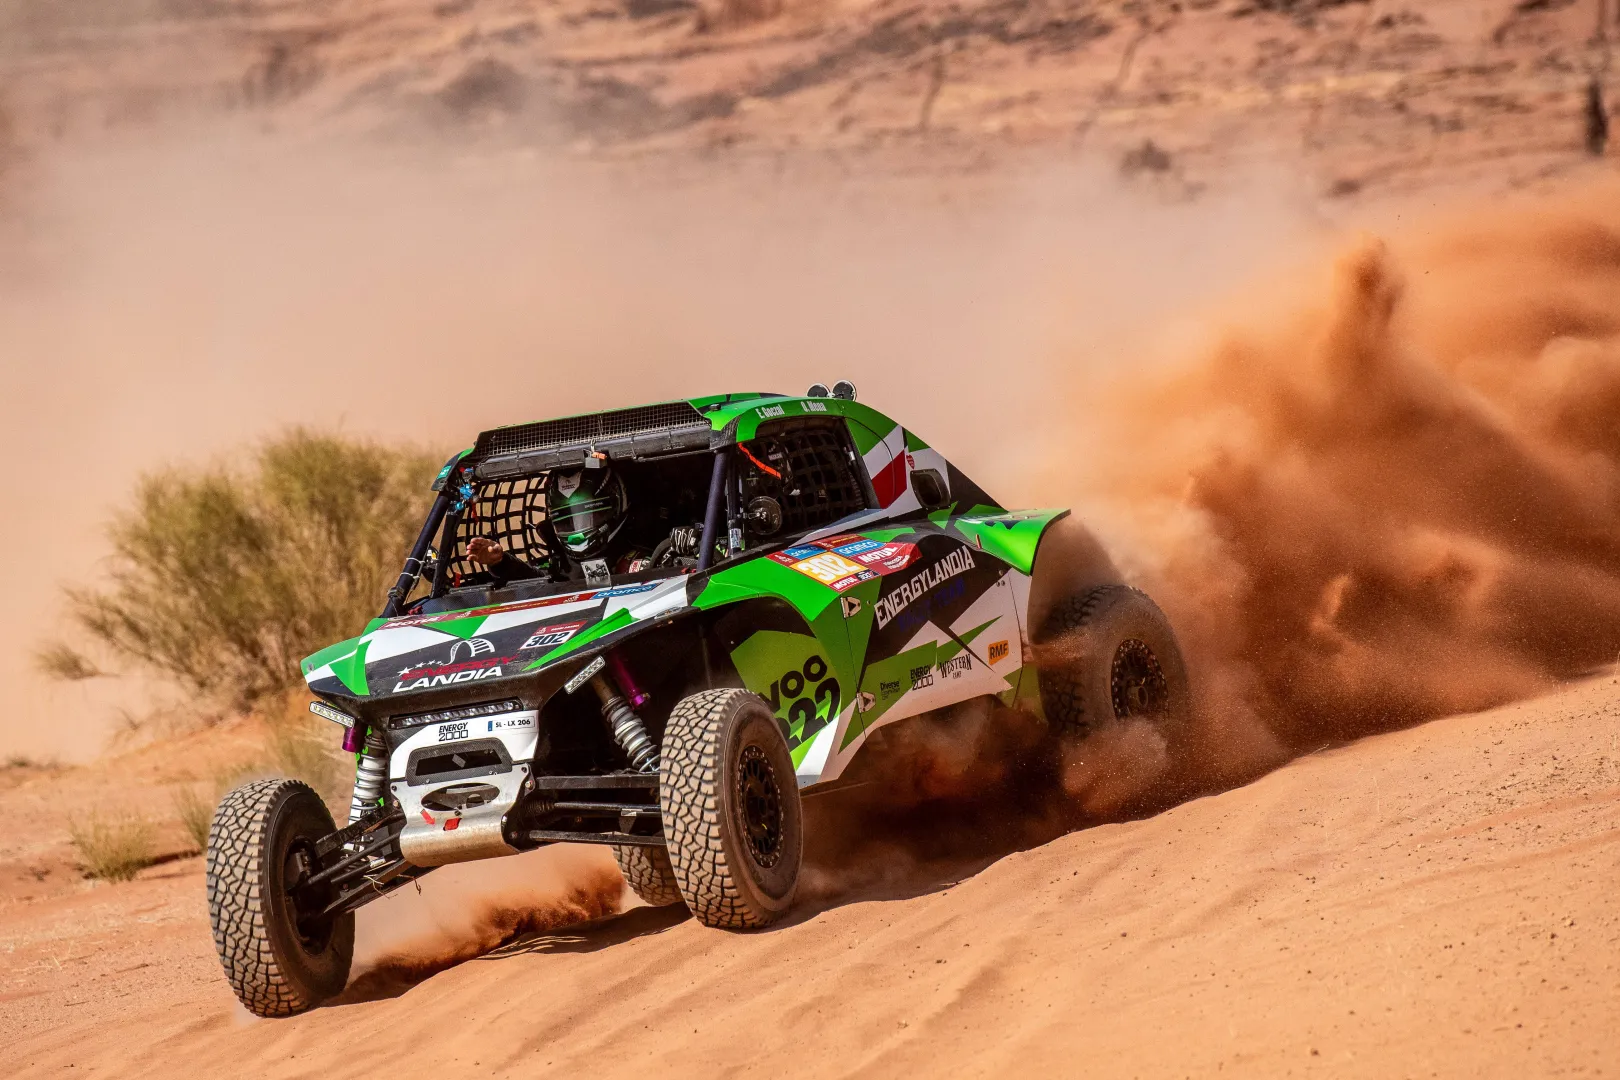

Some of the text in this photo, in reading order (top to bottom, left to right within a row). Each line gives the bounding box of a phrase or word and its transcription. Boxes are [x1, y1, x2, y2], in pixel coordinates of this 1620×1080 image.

[857, 547, 898, 563] MOTUL
[797, 554, 860, 581] 302
[597, 585, 652, 597] aramco
[833, 577, 858, 589] MOTUL
[874, 545, 975, 630] ENERGYLANDIA
[525, 631, 571, 648] 302
[989, 643, 1008, 659] RMF
[399, 653, 520, 680] ENERGY
[910, 665, 932, 679] ENERGY
[940, 653, 972, 679] WESTERN
[392, 666, 502, 693] LANDIA
[880, 680, 900, 691] Diverse
[911, 674, 934, 691] 2000
[439, 722, 469, 733] ENERGY
[438, 730, 469, 742] 2000
